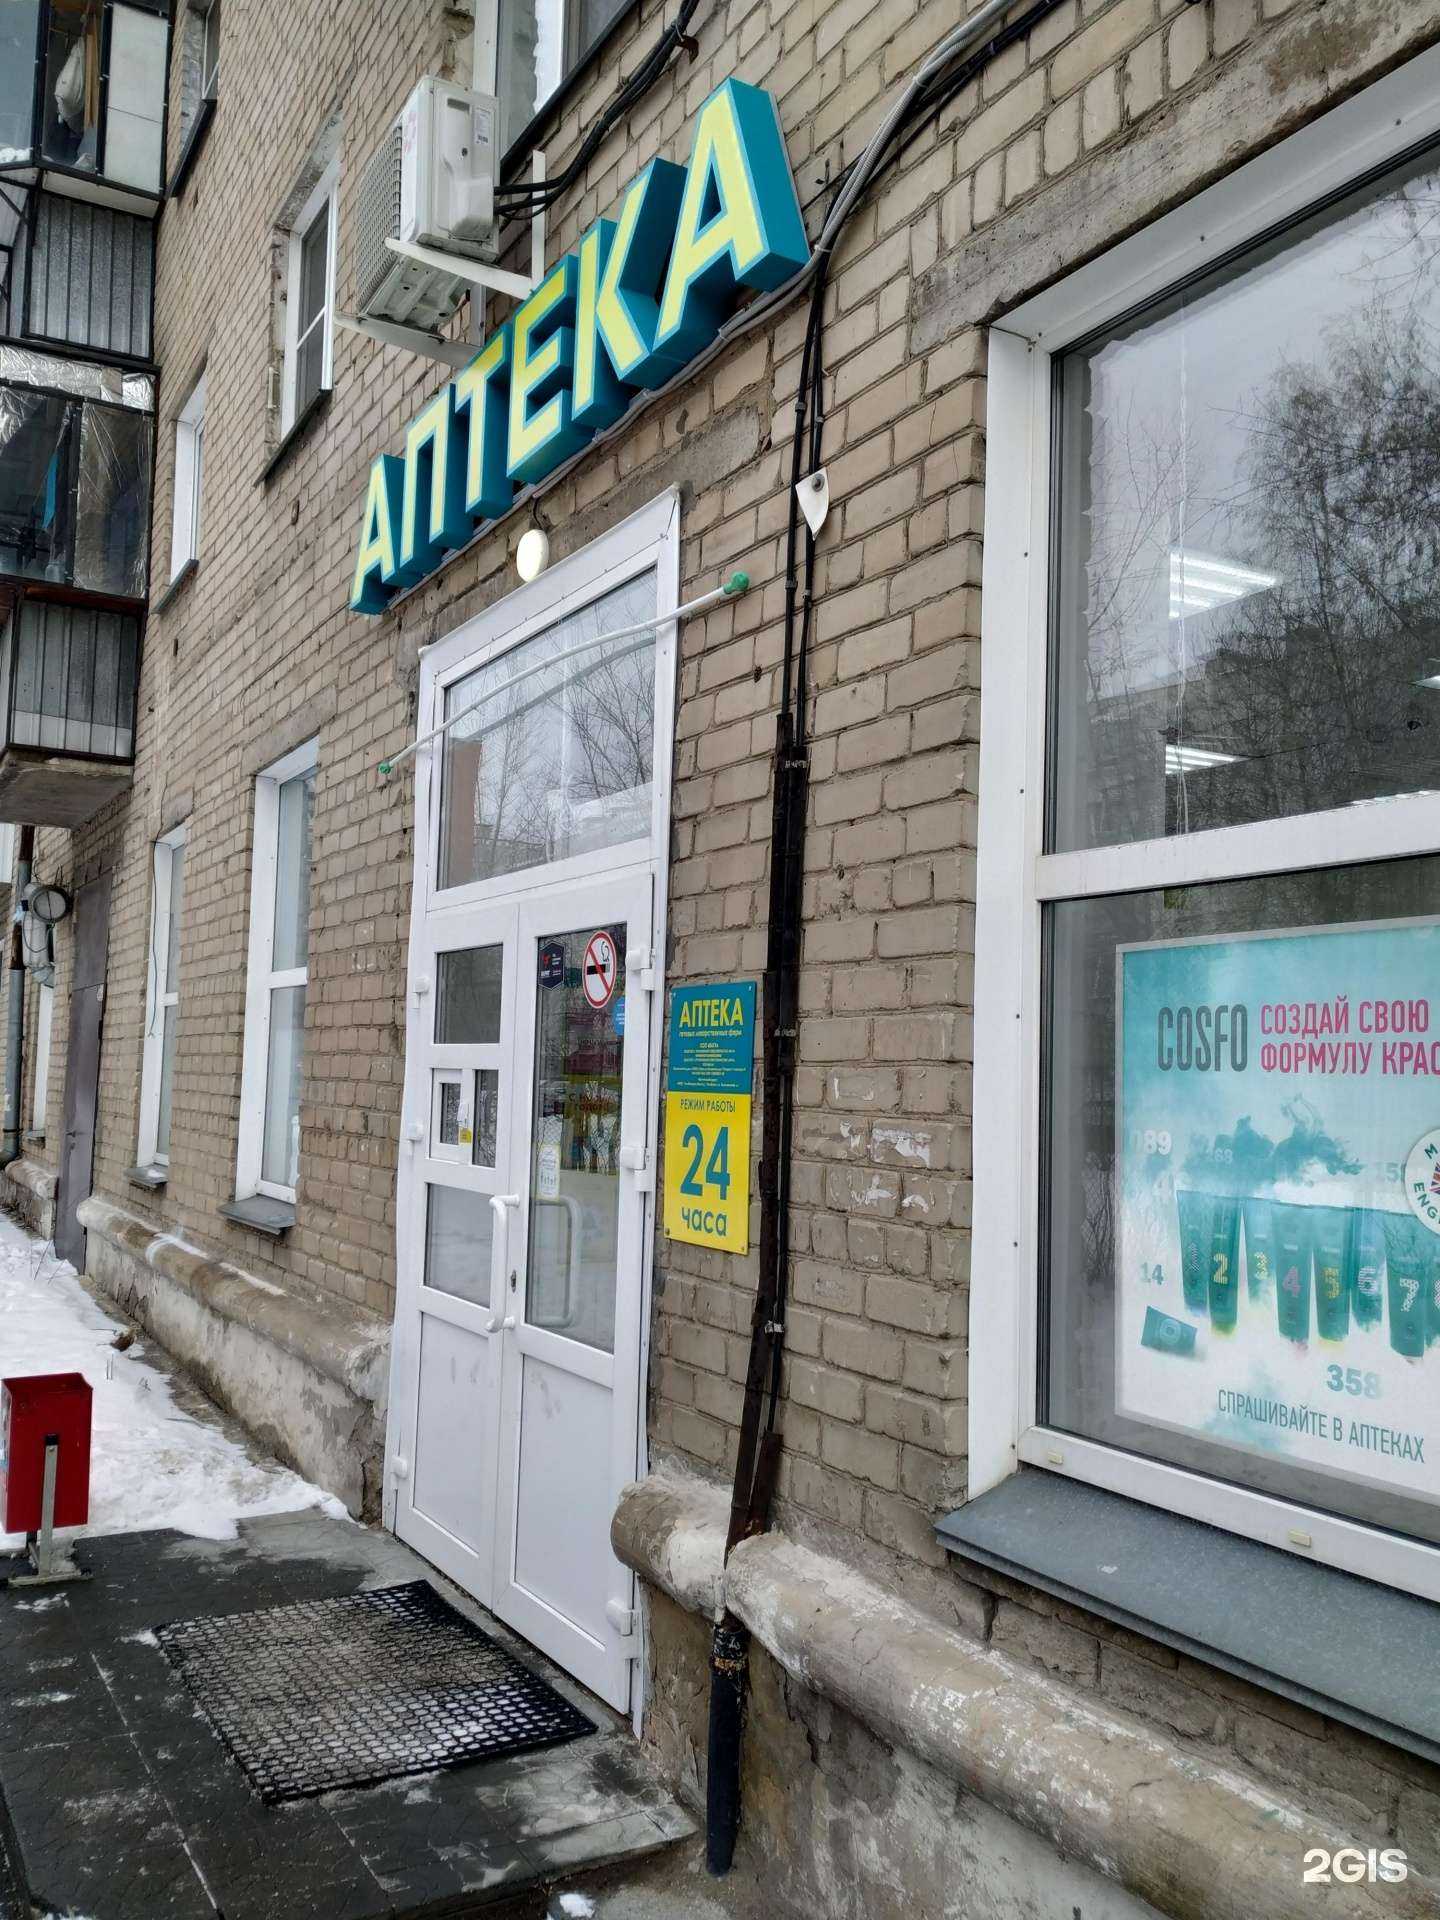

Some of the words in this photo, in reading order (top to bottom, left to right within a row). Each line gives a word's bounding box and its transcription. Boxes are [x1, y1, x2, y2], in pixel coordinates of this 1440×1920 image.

[350, 79, 790, 612] АПТЕКА
[678, 997, 744, 1028] АПТЕКА
[1260, 994, 1350, 1039] СОЗДАЙ
[1358, 999, 1429, 1034] СВОЮ
[1157, 1003, 1248, 1072] COSFO
[1260, 1041, 1373, 1073] ФОРМУЛУ
[680, 1098, 705, 1112] РЕЖИМ
[706, 1100, 737, 1114] РАБОТЫ
[680, 1123, 731, 1201] 24
[681, 1205, 727, 1238] часа
[1212, 1252, 1229, 1285] 2
[1281, 1265, 1301, 1298] 4
[1399, 1277, 1420, 1313] 7
[1325, 1363, 1384, 1399] 358
[1217, 1388, 1328, 1439] СПРАШИВАЙТЕ
[1333, 1416, 1344, 1442] В
[1349, 1421, 1425, 1464] АПТЕКАХ
